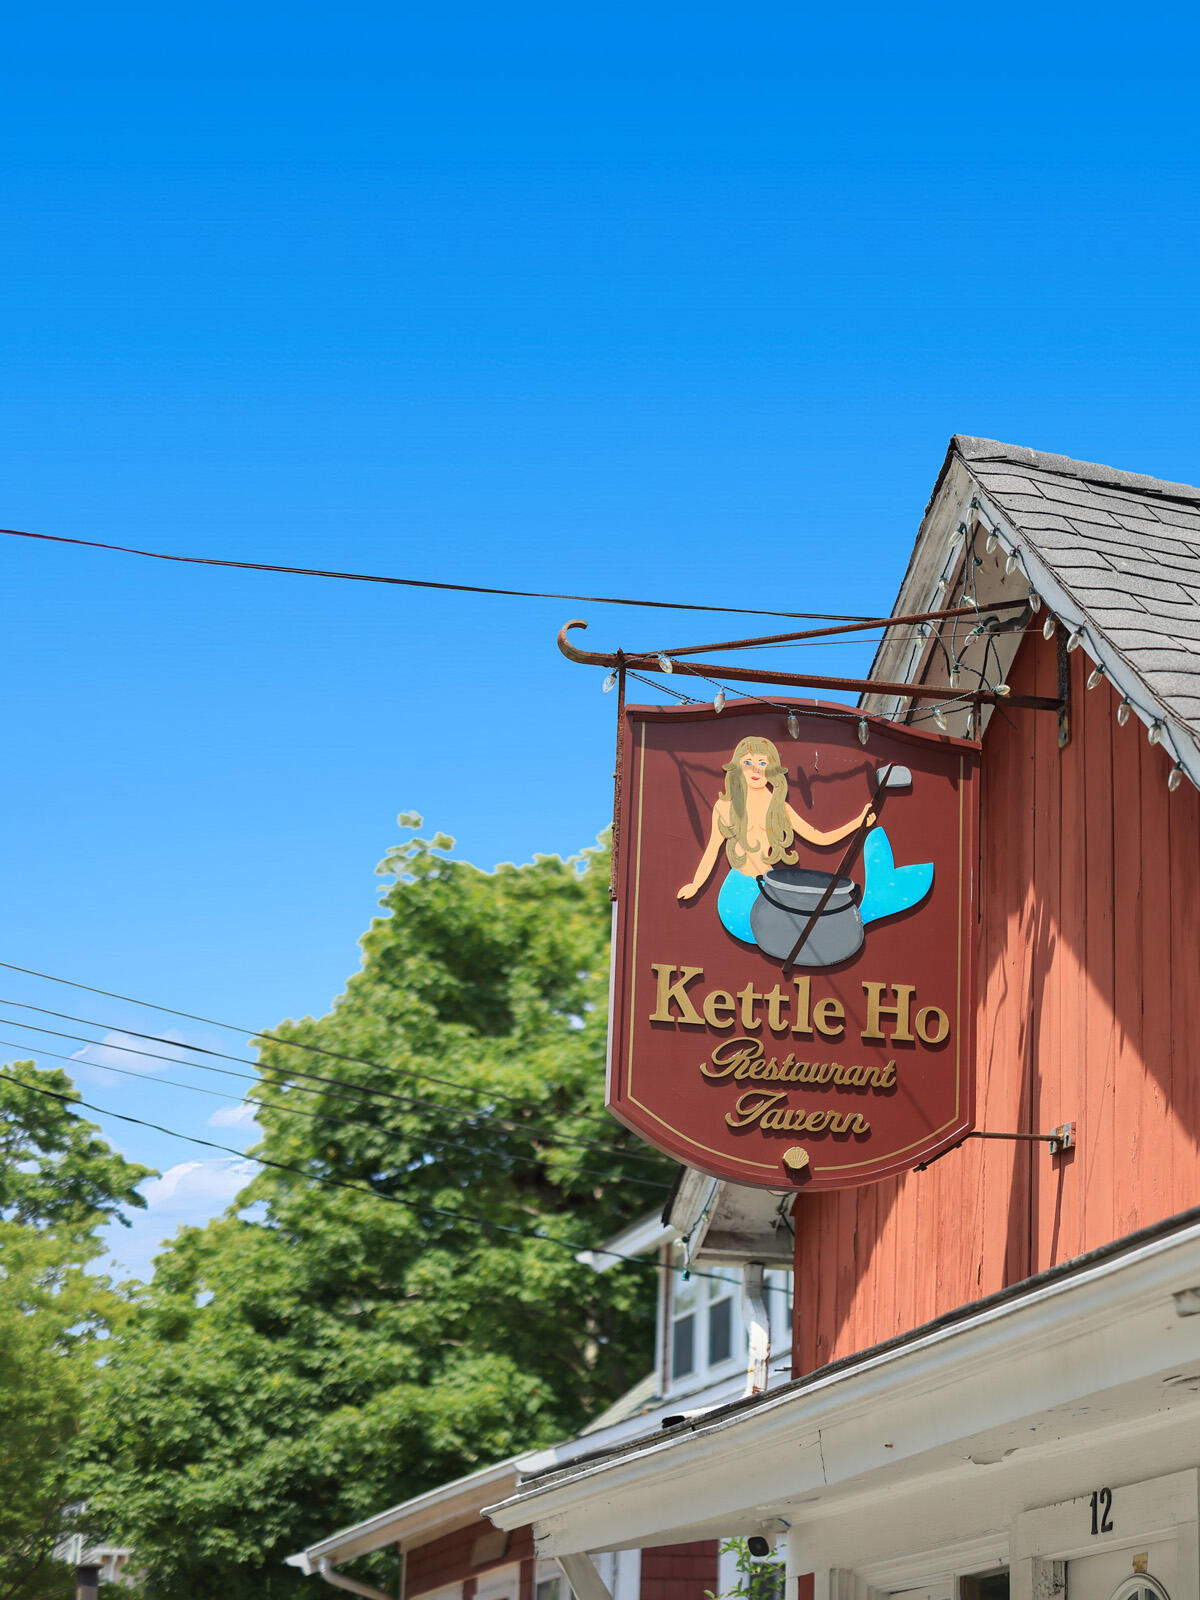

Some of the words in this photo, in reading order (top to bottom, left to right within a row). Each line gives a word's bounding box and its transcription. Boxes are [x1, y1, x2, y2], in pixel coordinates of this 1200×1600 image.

[649, 963, 846, 1036] Kettle
[860, 981, 950, 1044] Ho
[700, 1037, 897, 1088] Restaurant
[725, 1090, 871, 1134] Tavern
[1090, 1487, 1113, 1535] 12
